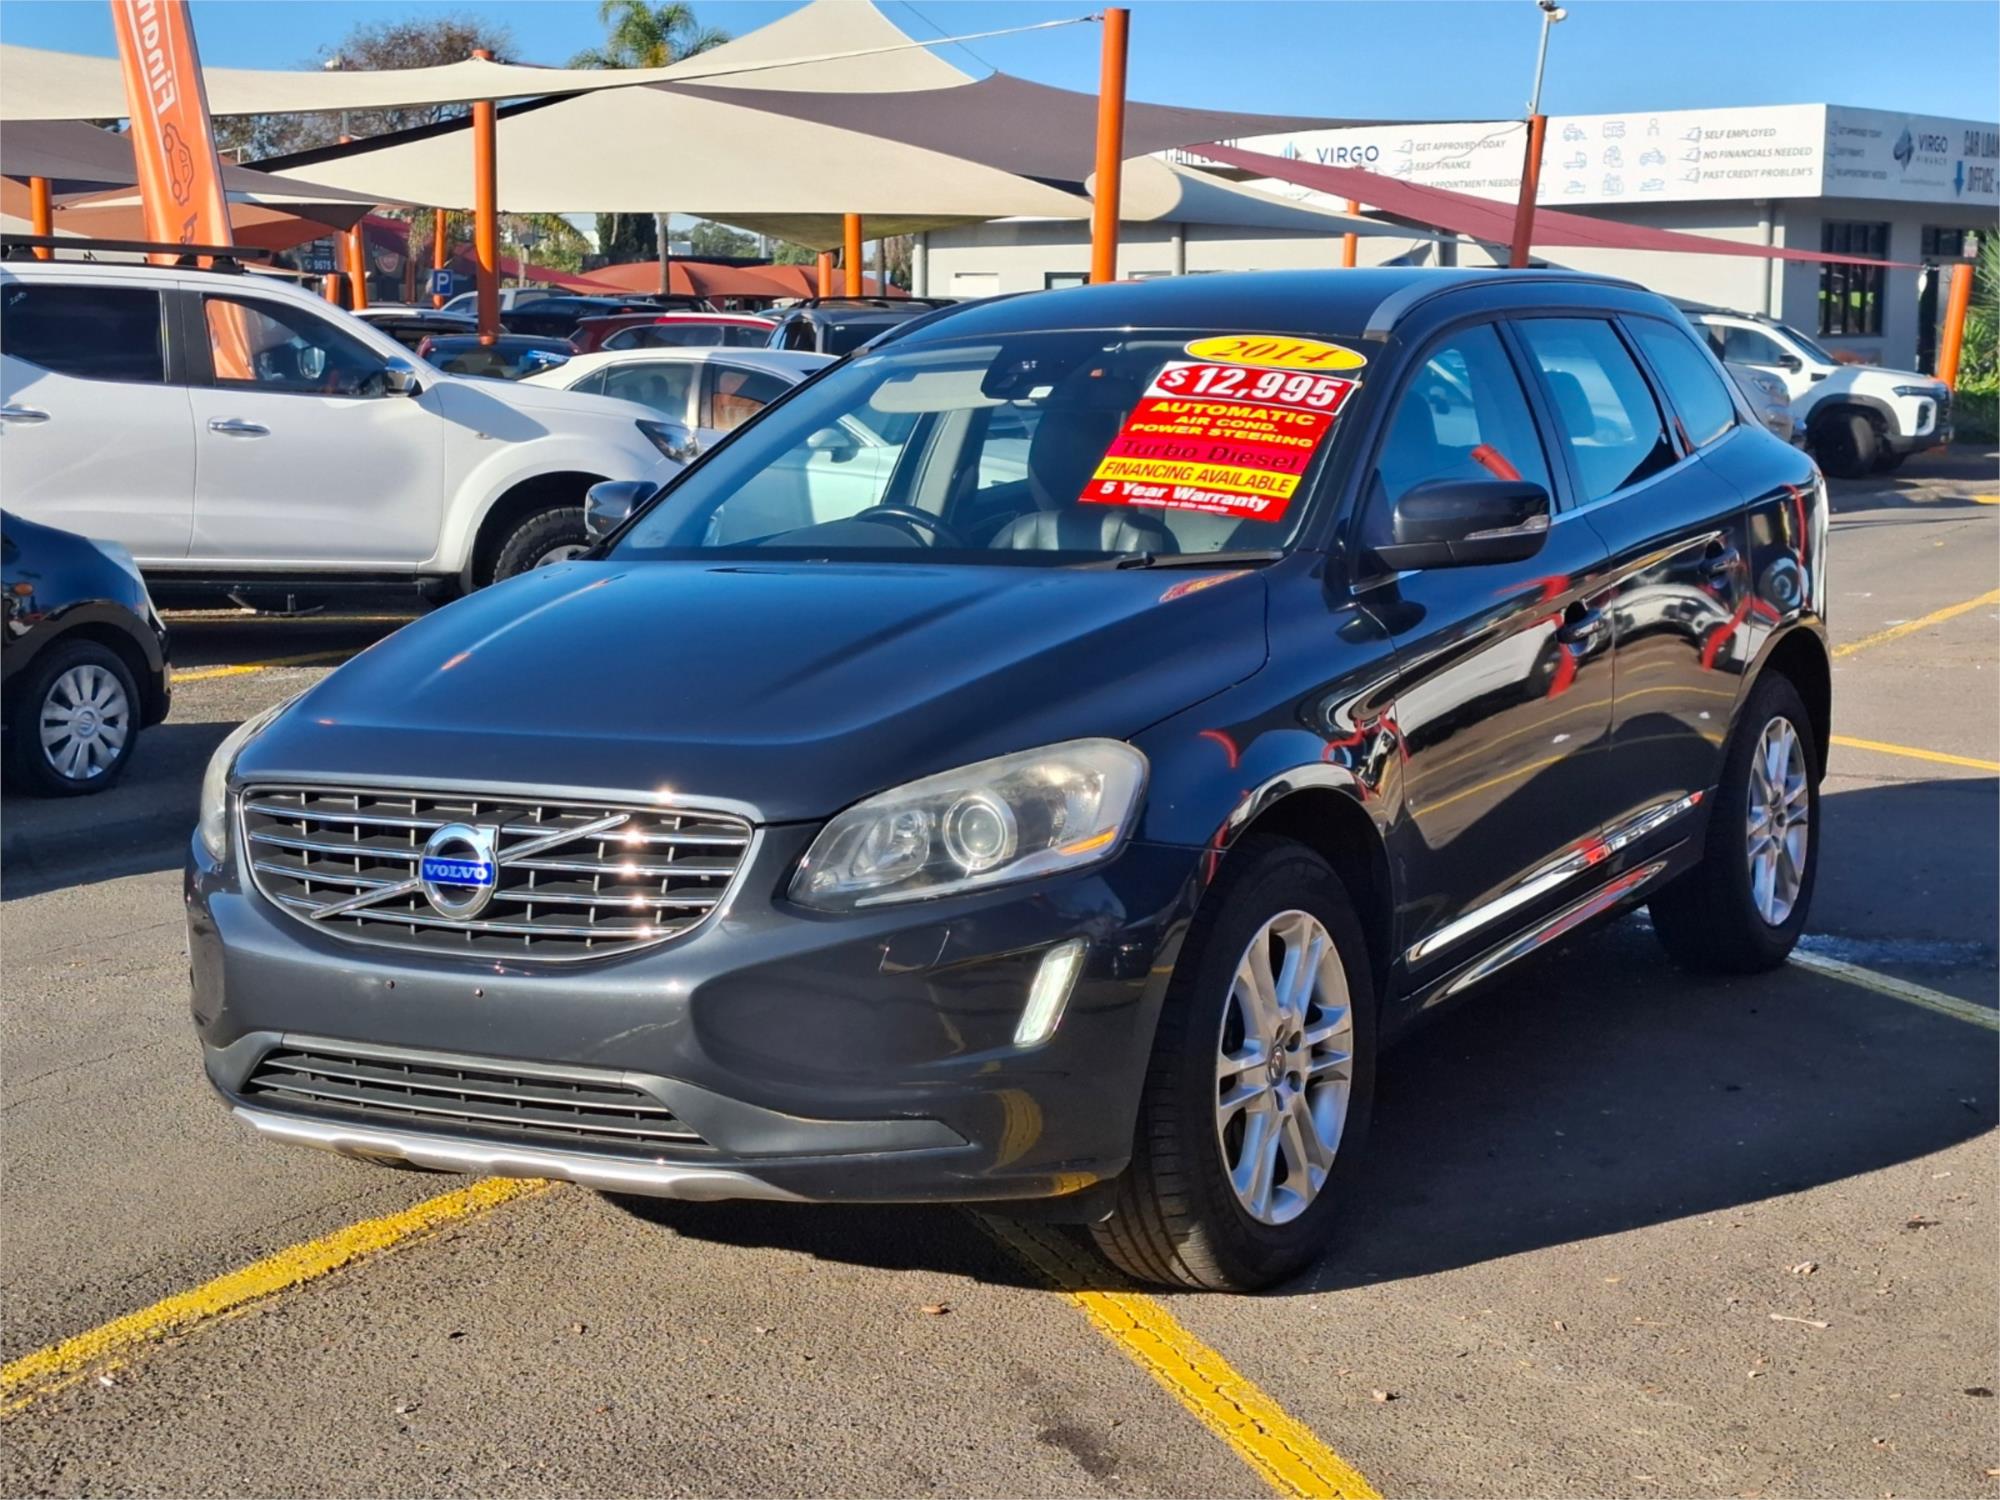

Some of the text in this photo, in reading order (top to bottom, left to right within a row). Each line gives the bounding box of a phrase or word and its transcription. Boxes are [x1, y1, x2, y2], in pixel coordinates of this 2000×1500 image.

[1704, 128, 1776, 140] SELF EMPLOYED
[1918, 134, 1948, 153] VIRGO
[1964, 130, 1980, 157] CAR
[1316, 145, 1379, 164] VIRGO
[1415, 143, 1431, 152] GET
[1703, 147, 1813, 160] NO FINANCIALS NEEDED
[1703, 169, 1725, 179] PAST
[1727, 168, 1760, 179] CREDIT
[1967, 166, 1995, 193] OFFICE
[436, 272, 449, 293] P
[1209, 341, 1339, 364] 2014
[1150, 401, 1317, 426] AUTOMATIC
[1174, 416, 1279, 432] AIR COND.
[1130, 423, 1314, 447] POWER STEERING
[1122, 439, 1299, 470] Turbo Diesel
[1102, 461, 1292, 493] FINANCING AVAILABLE
[1100, 481, 1271, 512] 5 Year Warranty
[425, 863, 488, 880] VOLVO
